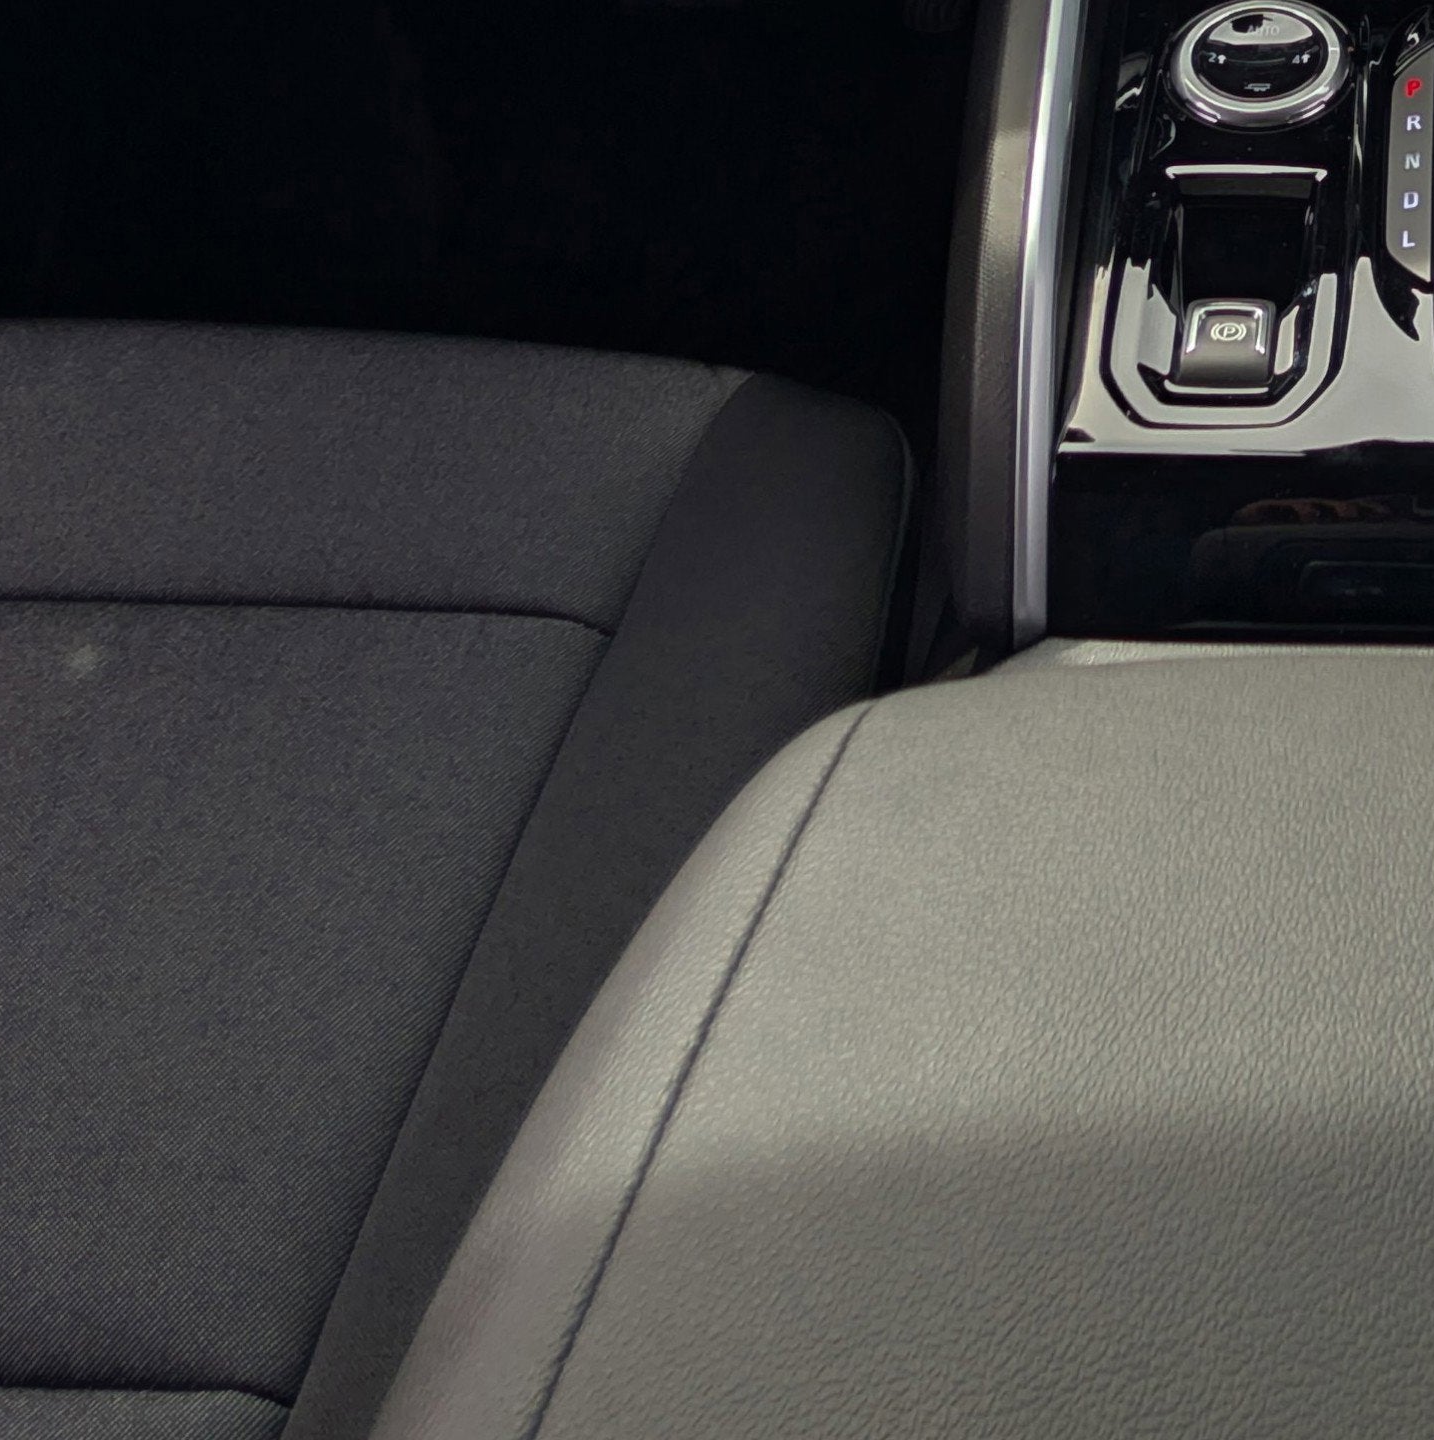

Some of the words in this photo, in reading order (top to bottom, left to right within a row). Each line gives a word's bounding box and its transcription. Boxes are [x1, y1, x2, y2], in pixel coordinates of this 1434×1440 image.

[1404, 78, 1421, 97] P
[1406, 115, 1421, 131] R
[1405, 153, 1420, 170] N
[1403, 191, 1419, 209] D
[1402, 230, 1415, 247] L
